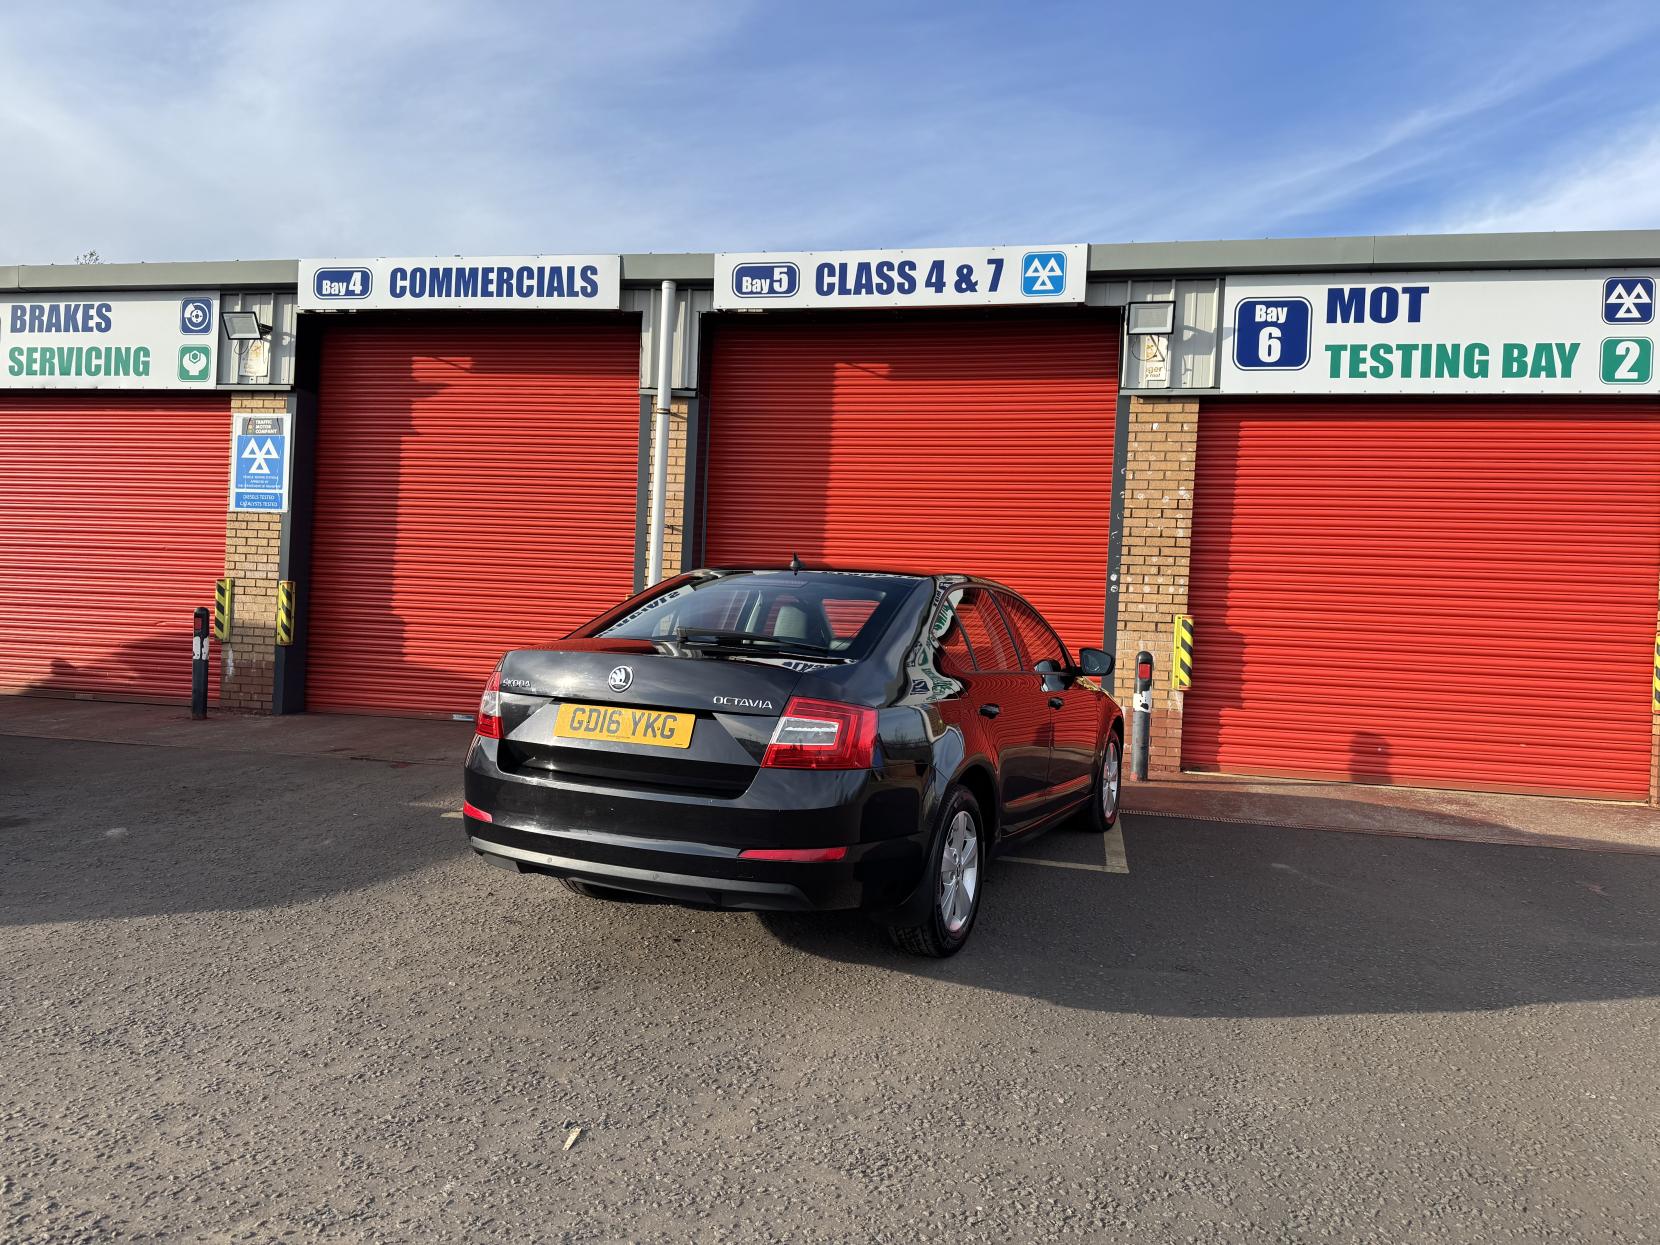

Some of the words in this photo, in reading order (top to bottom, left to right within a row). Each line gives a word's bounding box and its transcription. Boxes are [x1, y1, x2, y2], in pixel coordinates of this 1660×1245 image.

[321, 279, 347, 297] Bay
[348, 271, 363, 295] 4
[389, 265, 599, 299] COMMERCIALS
[741, 276, 770, 295] Bay
[773, 267, 788, 294] 5
[815, 261, 917, 297] CLASS
[925, 259, 946, 294] 4
[954, 263, 978, 294] &
[987, 258, 1004, 293] 7
[9, 302, 112, 334] BRAKES
[1254, 304, 1288, 324] Bay
[1325, 286, 1430, 324] MOT
[8, 346, 151, 377] SERVICING
[1258, 326, 1282, 364] 6
[1324, 342, 1490, 380] TESTING
[1501, 341, 1581, 380] BAY
[1613, 340, 1640, 381] 2
[712, 695, 774, 710] OCTAVIA
[569, 707, 624, 735] GD16
[630, 710, 678, 740] YKG
